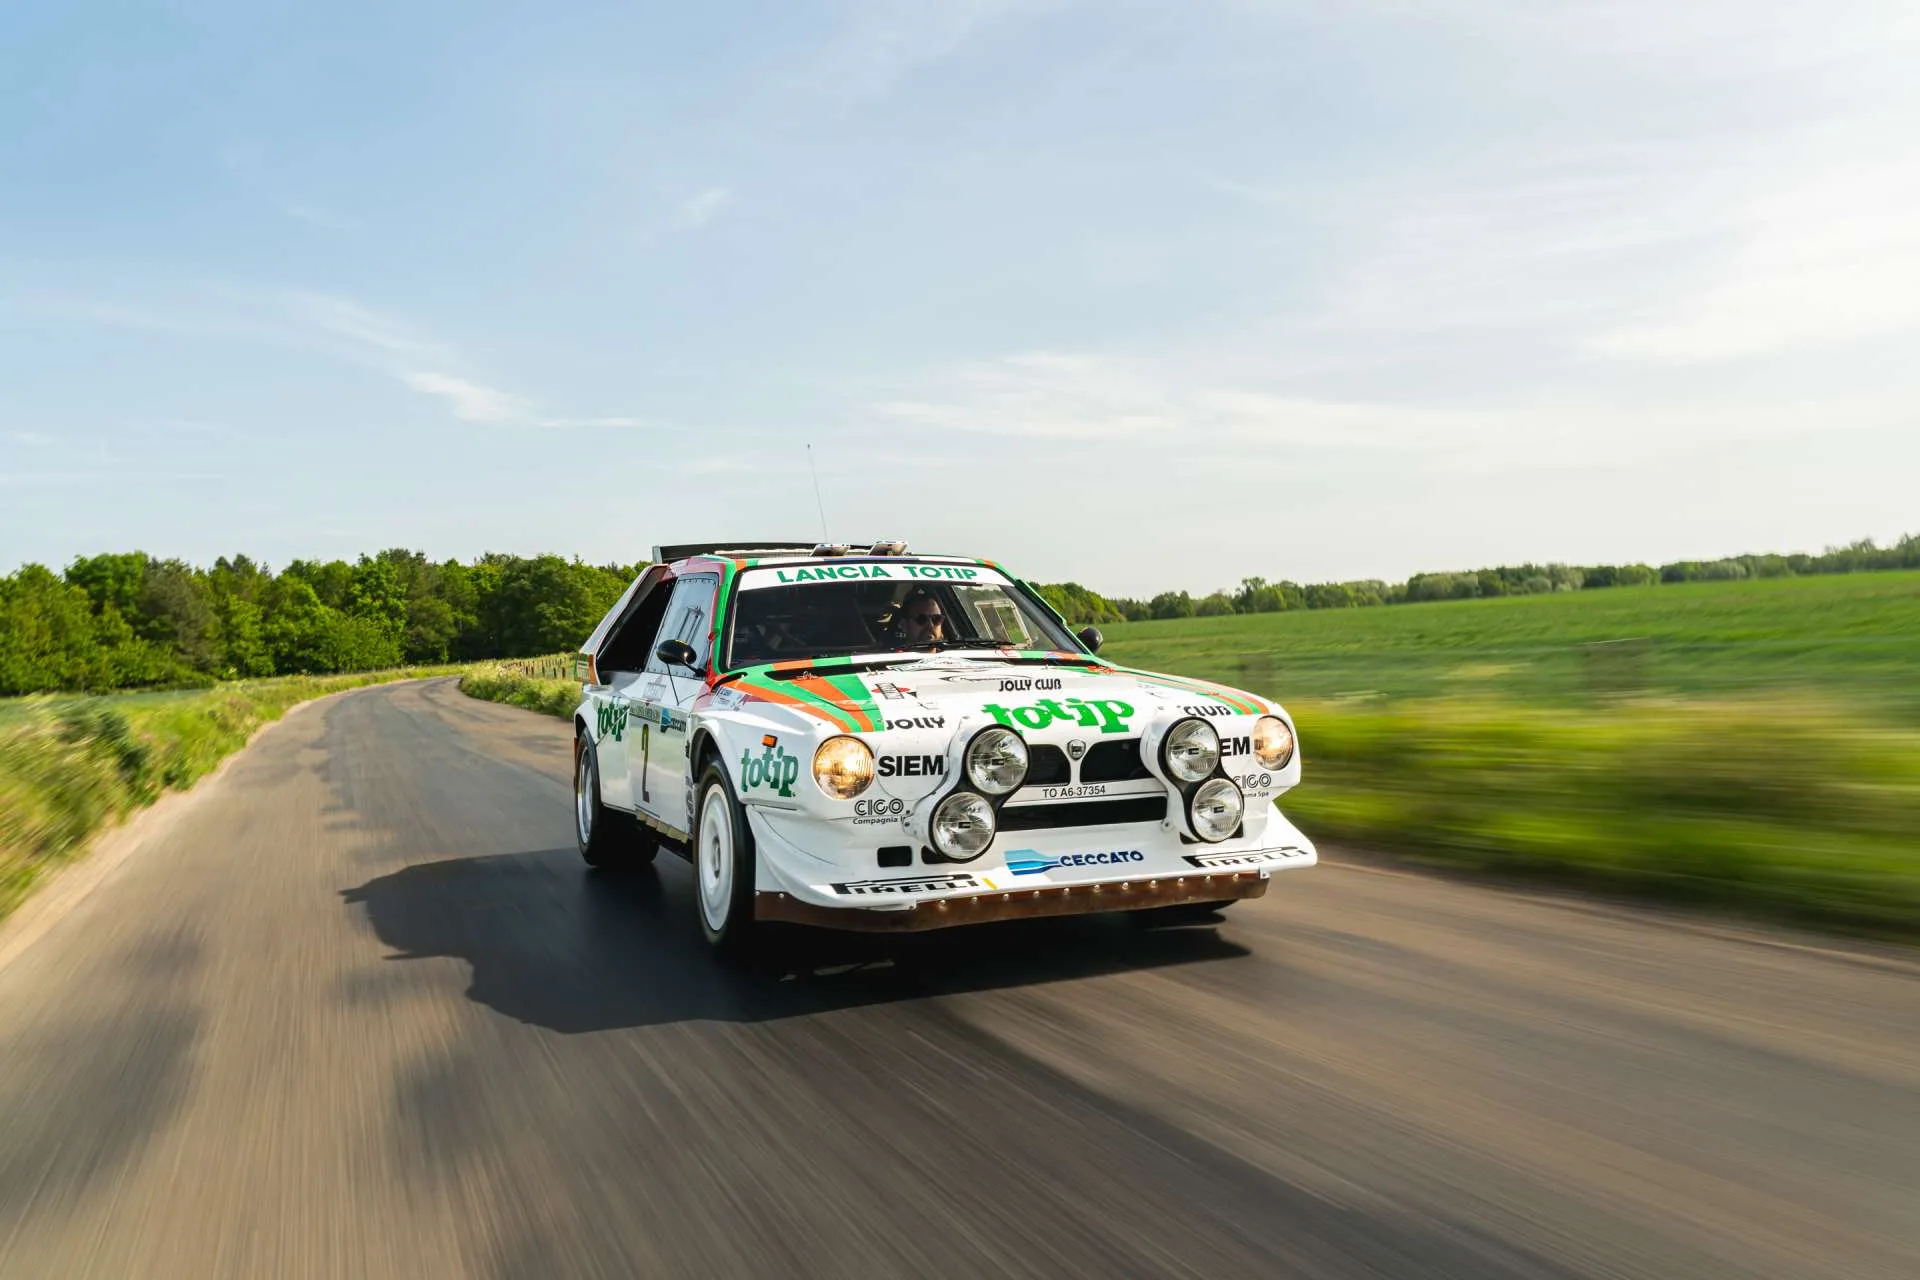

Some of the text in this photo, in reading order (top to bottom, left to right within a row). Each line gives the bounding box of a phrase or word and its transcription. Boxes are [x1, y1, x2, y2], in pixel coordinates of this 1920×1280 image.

[776, 565, 978, 584] LANCIA TOTIP
[999, 679, 1062, 692] JOLLY CLUB
[886, 715, 946, 731] JOLLY
[980, 698, 1135, 737] totip
[1220, 736, 1250, 757] EM
[740, 745, 798, 798] totip
[877, 755, 944, 777] SIEM
[1042, 788, 1057, 798] TO
[854, 798, 904, 816] CICO
[852, 816, 898, 825] Compagnia
[1060, 850, 1144, 867] CECCATO
[1180, 846, 1309, 868] PIRELLI
[830, 873, 979, 895] PIRELLI
